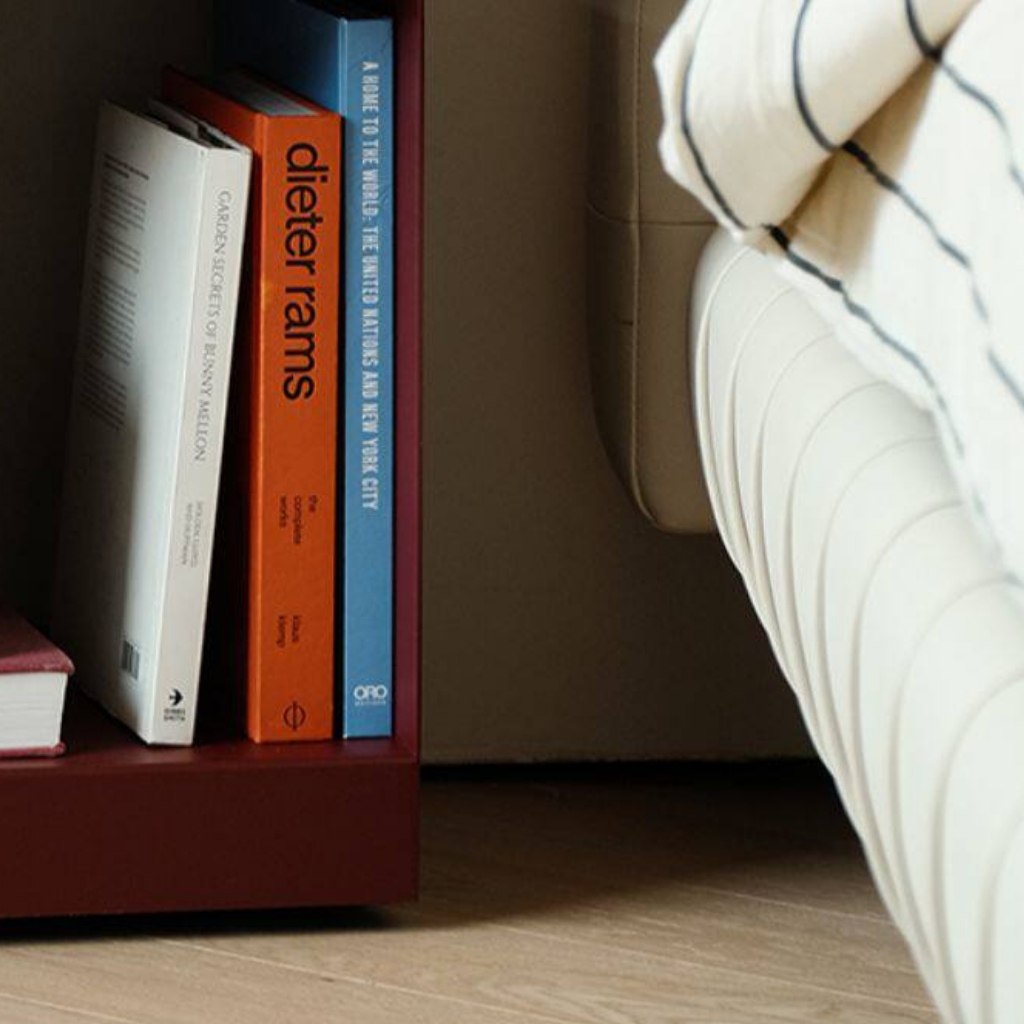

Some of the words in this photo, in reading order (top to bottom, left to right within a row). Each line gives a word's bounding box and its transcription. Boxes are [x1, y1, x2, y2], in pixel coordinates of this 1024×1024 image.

[362, 61, 379, 71] A
[362, 75, 379, 112] HOME
[362, 118, 379, 135] TO
[362, 139, 379, 165] THE
[285, 143, 329, 275] dieter
[362, 169, 379, 221] WORLD:
[214, 190, 232, 255] GARDEN
[362, 226, 379, 251] THE
[209, 257, 226, 321] SECRETS
[362, 255, 379, 304] UNITED
[206, 322, 219, 340] OF
[282, 286, 316, 401] rams
[362, 308, 379, 366] NATIONS
[200, 342, 217, 397] BUNNY
[362, 371, 379, 399] AND
[194, 399, 210, 463] MELLON
[362, 403, 379, 433] NEW
[362, 438, 379, 473] YORK
[362, 477, 379, 510] CITY
[292, 495, 303, 545] complete
